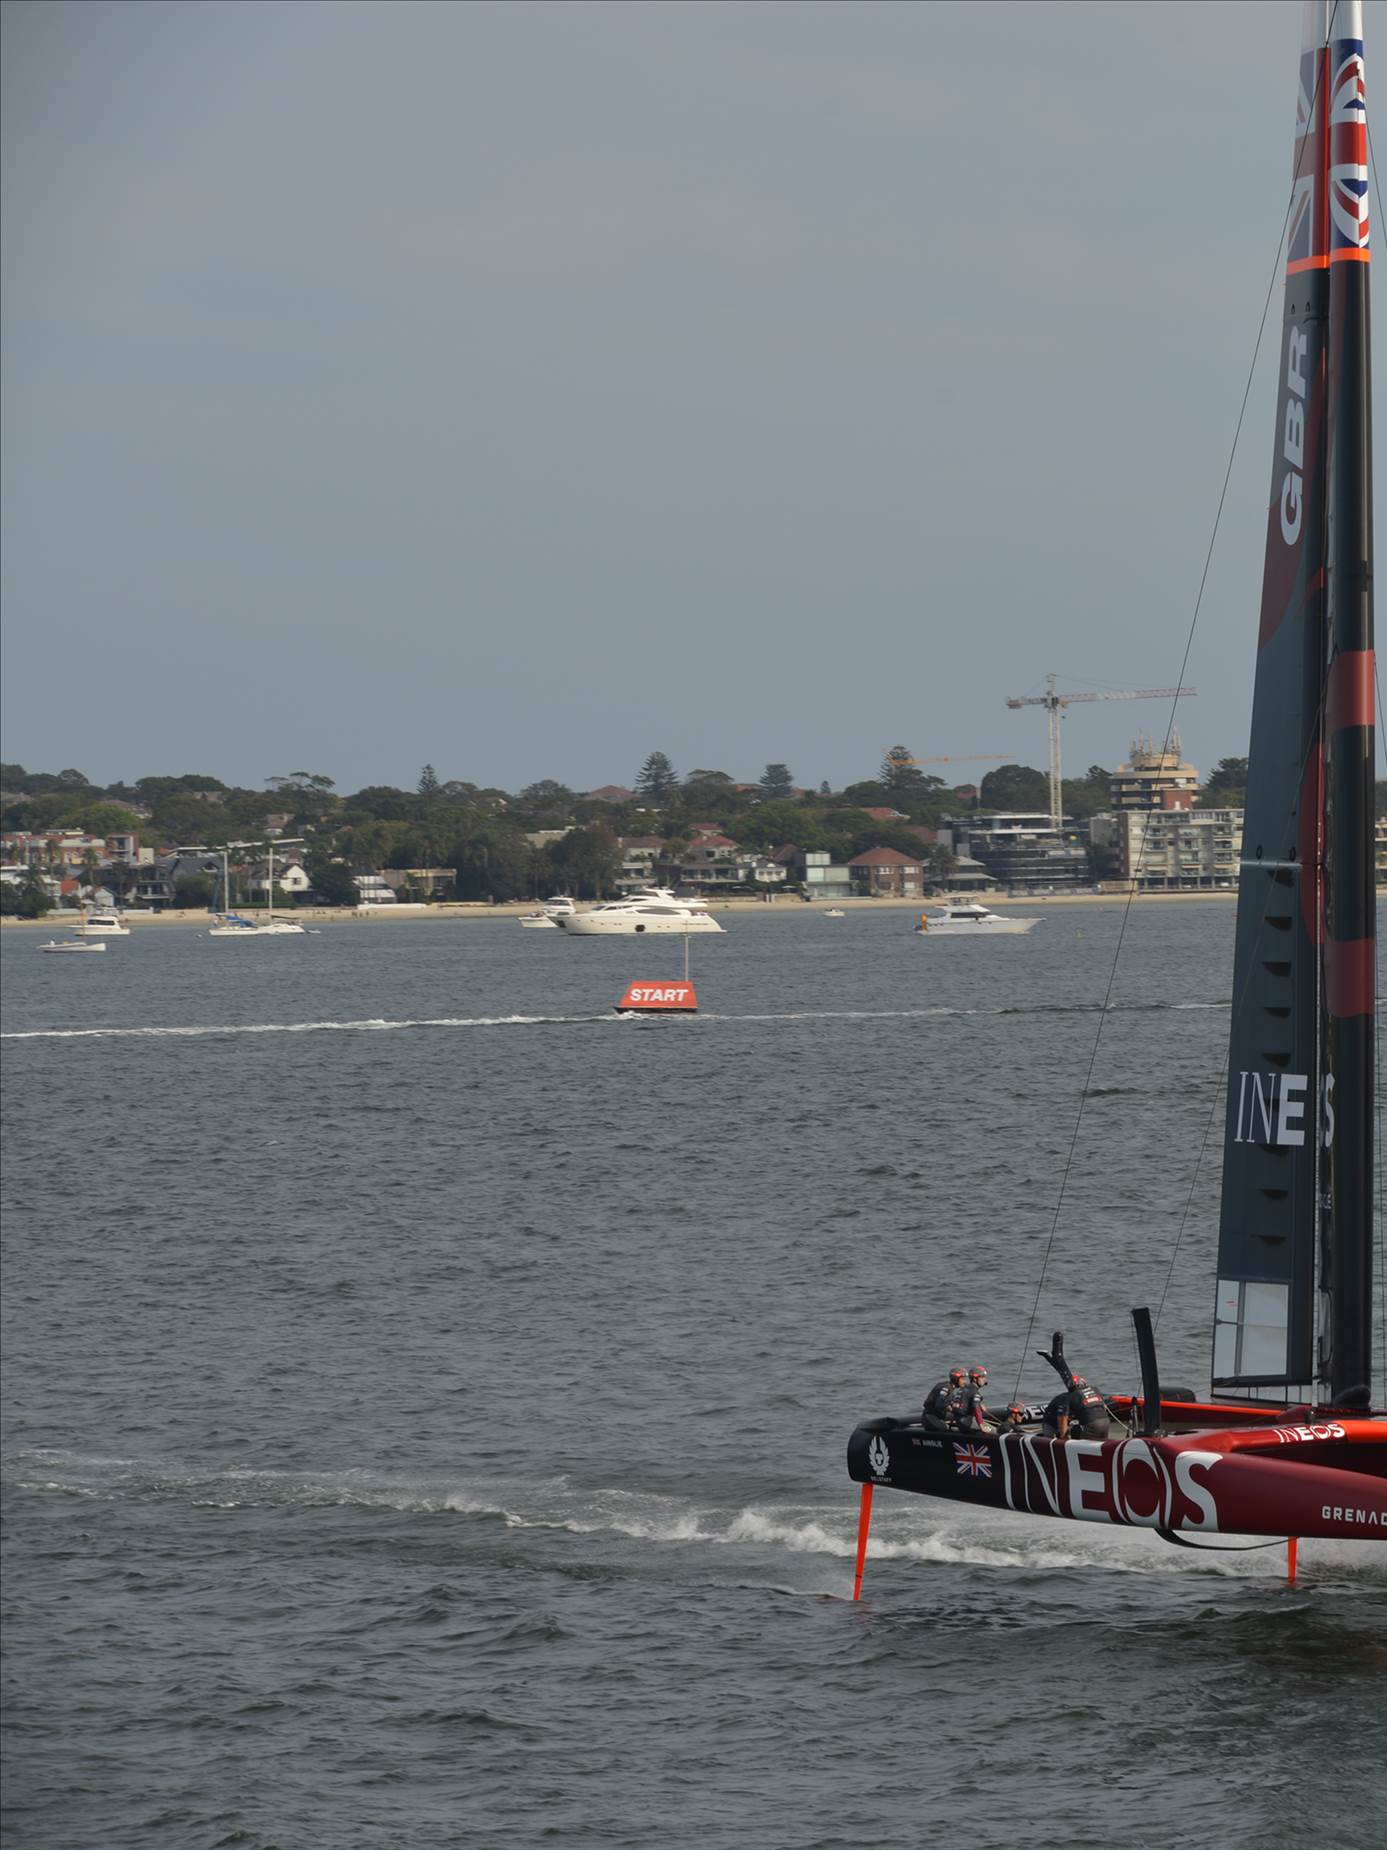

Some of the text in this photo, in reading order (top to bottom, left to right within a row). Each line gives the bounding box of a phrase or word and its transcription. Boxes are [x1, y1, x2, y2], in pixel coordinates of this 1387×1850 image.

[1280, 325, 1308, 546] GBR
[630, 988, 689, 1002] START
[1272, 1423, 1346, 1443] INEOS
[999, 1433, 1224, 1532] INEOS
